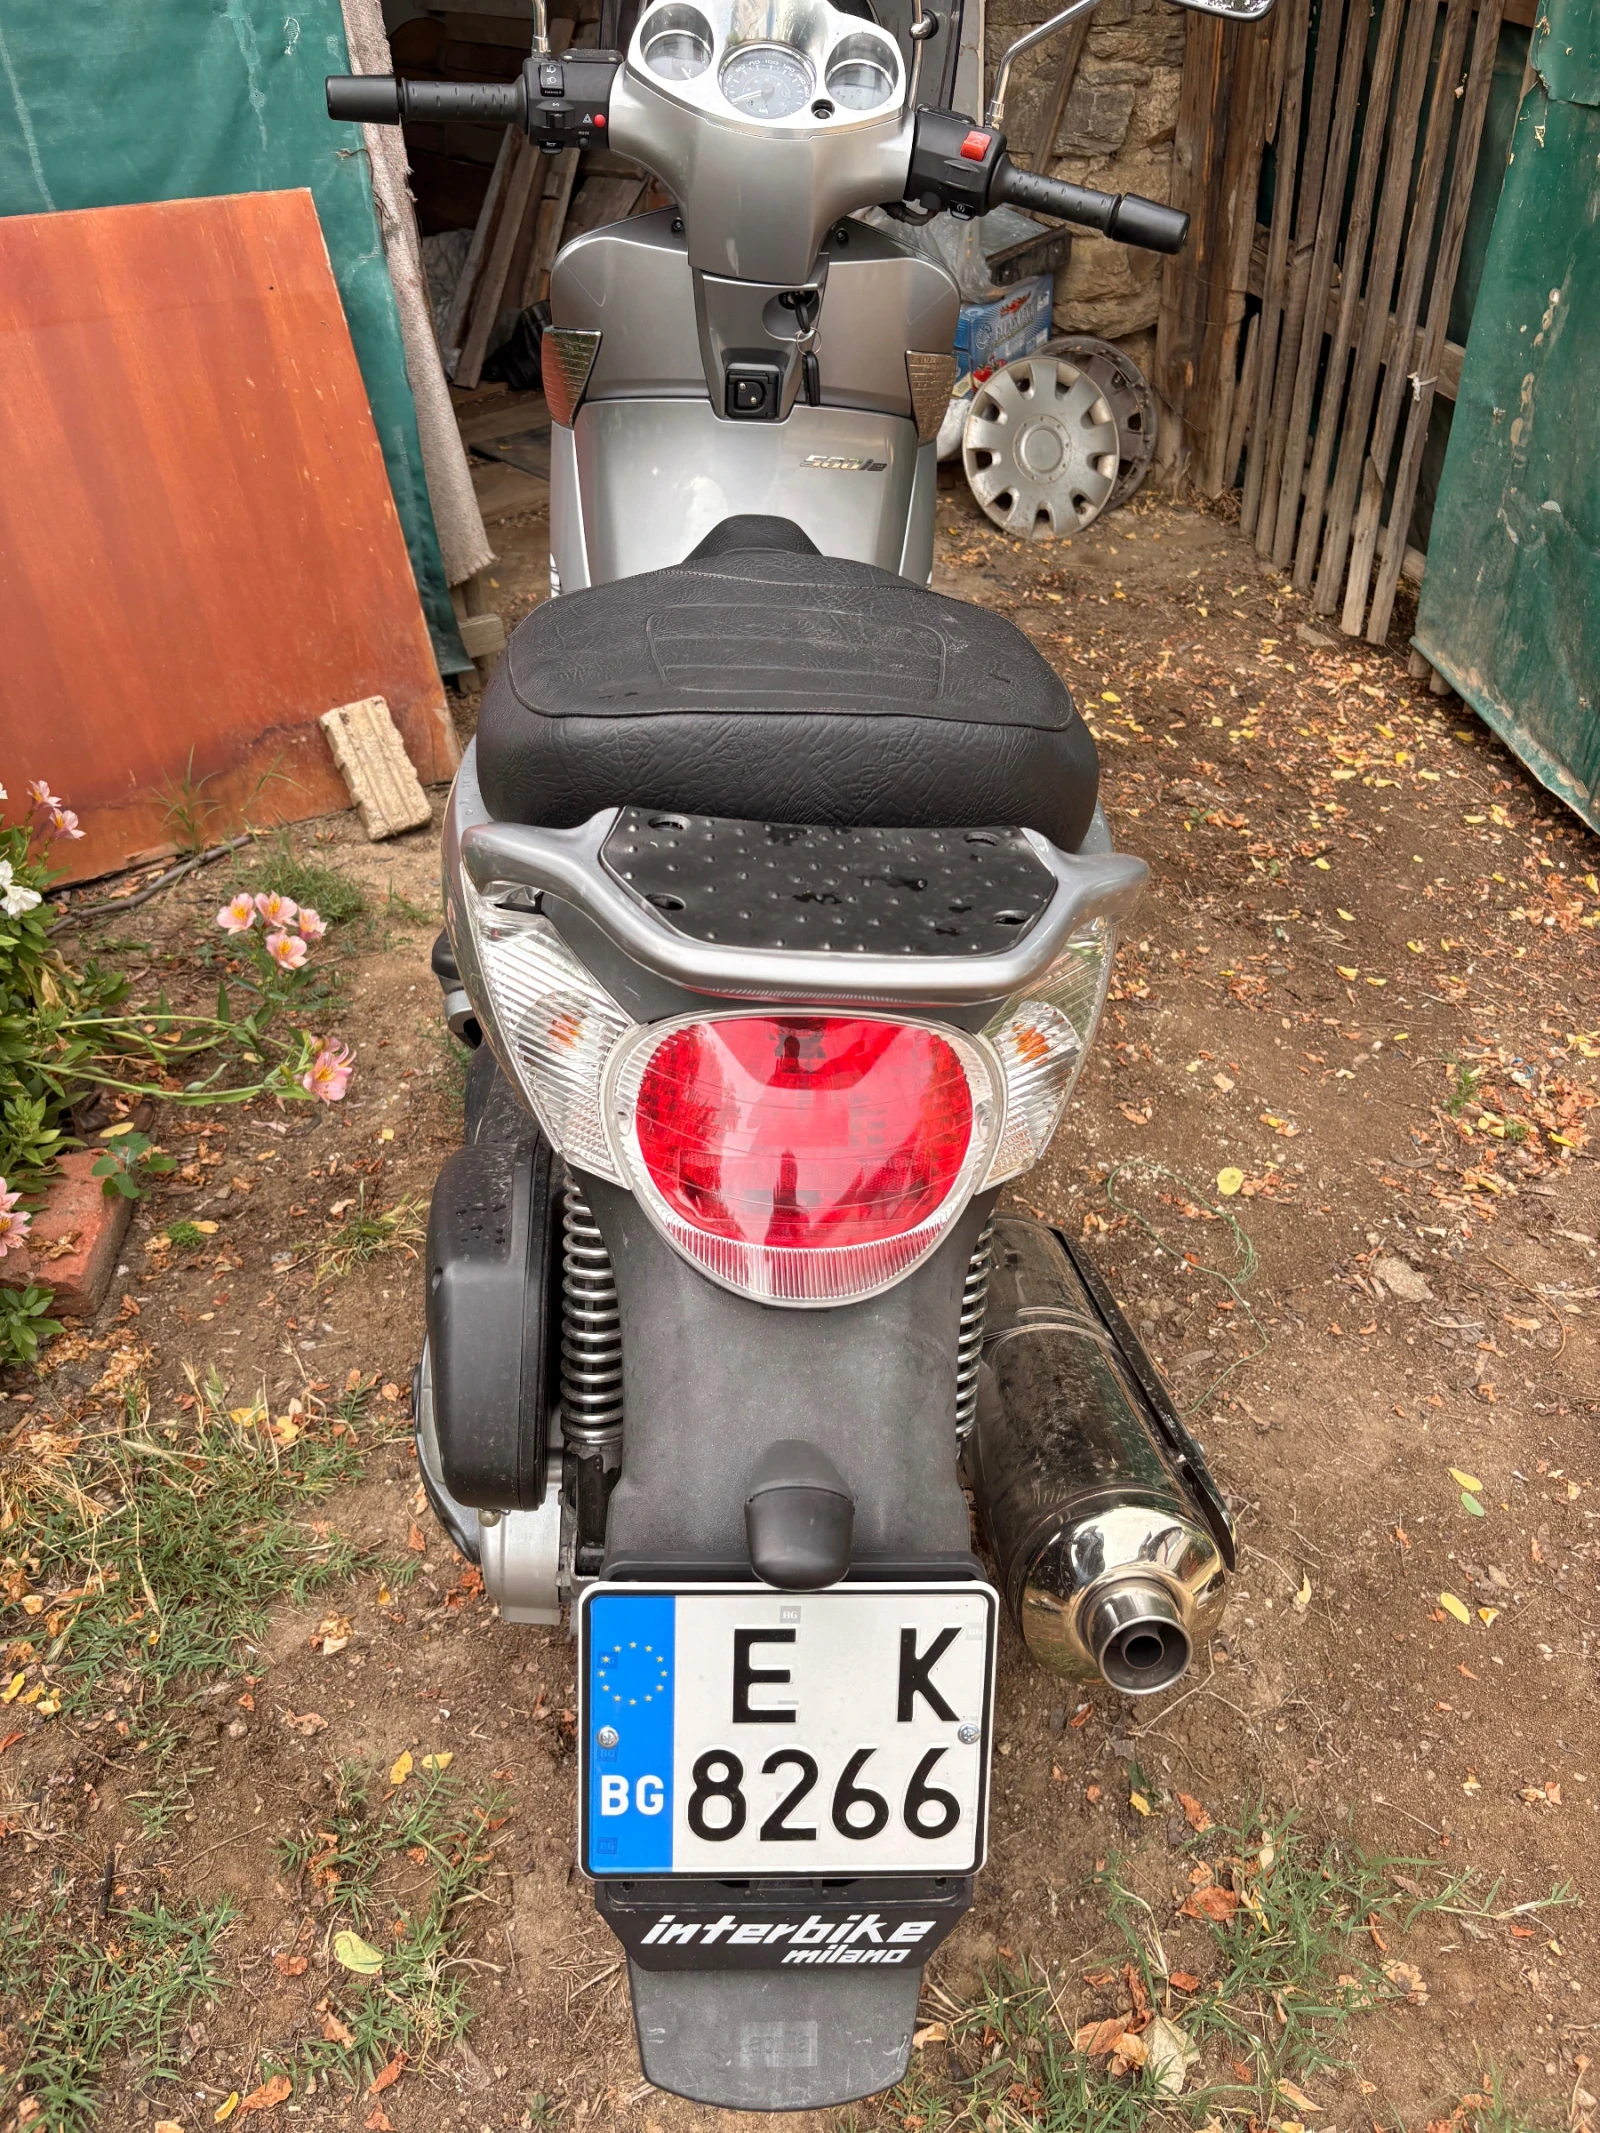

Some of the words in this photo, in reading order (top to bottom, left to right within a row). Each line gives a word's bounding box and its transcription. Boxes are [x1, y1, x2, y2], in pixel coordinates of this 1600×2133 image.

[732, 1627, 797, 1724] E
[896, 1626, 963, 1723] K
[600, 1774, 664, 1816] BG
[687, 1746, 961, 1842] 8266
[640, 1914, 937, 1944] interbike
[781, 1943, 912, 1964] milano
